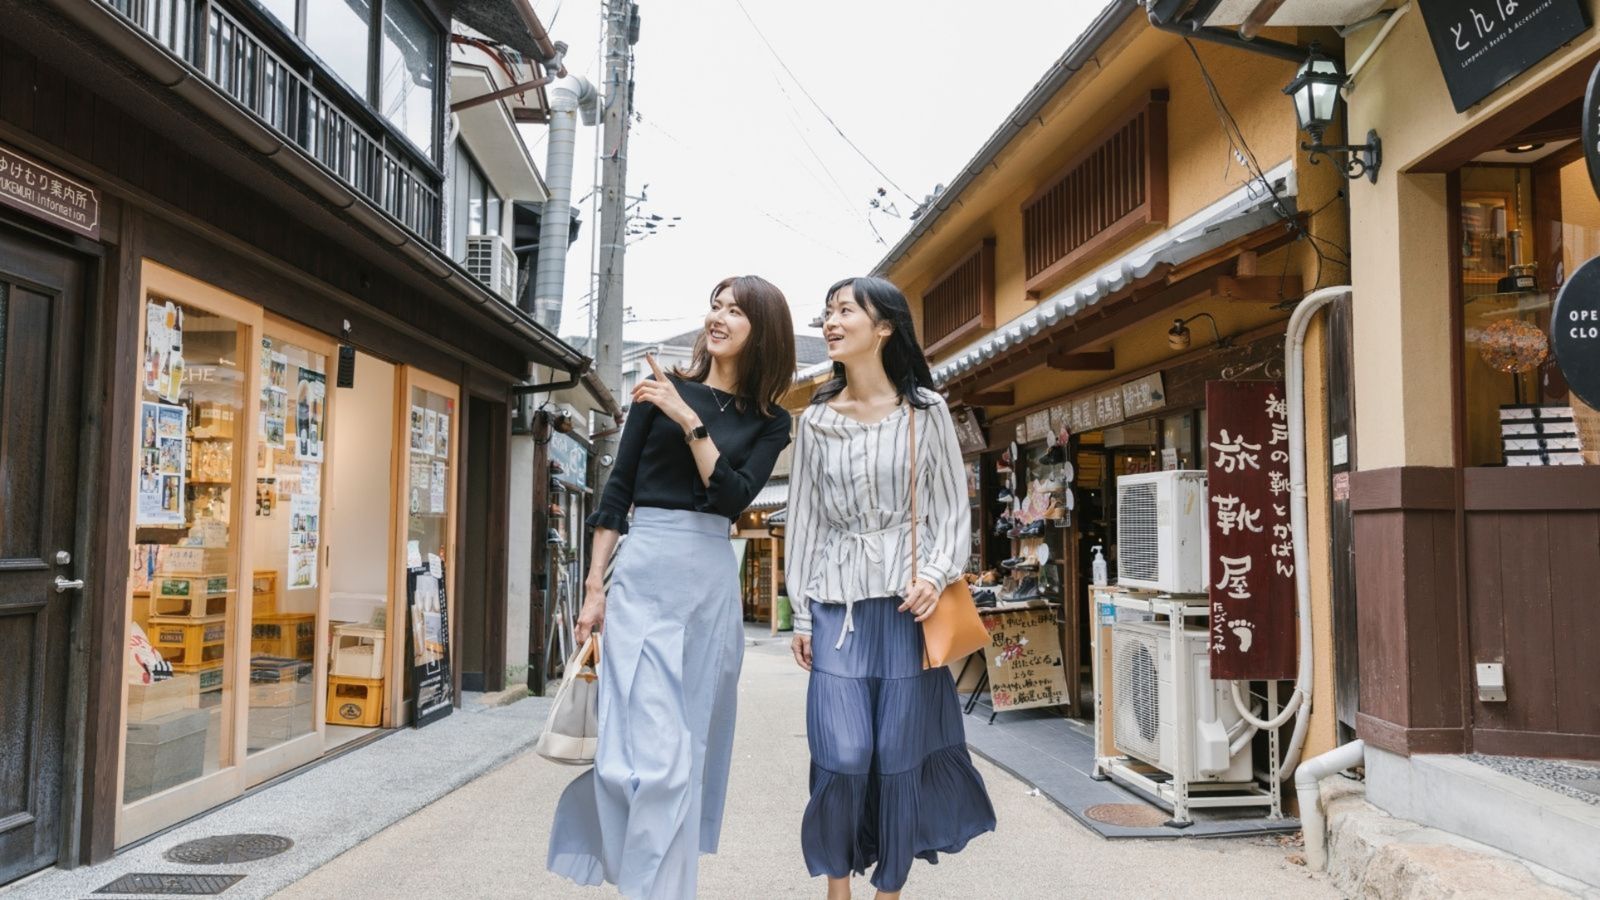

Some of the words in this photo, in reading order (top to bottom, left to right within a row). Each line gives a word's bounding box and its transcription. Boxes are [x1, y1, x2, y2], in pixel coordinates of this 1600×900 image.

[0, 156, 87, 210] ゆけむり案内所
[0, 176, 35, 203] UKEMURI
[37, 192, 86, 223] Information
[1264, 393, 1295, 578] 神戸の靴とかばん
[1210, 429, 1264, 599] 旅靴屋
[1213, 602, 1227, 654] たびくつや
